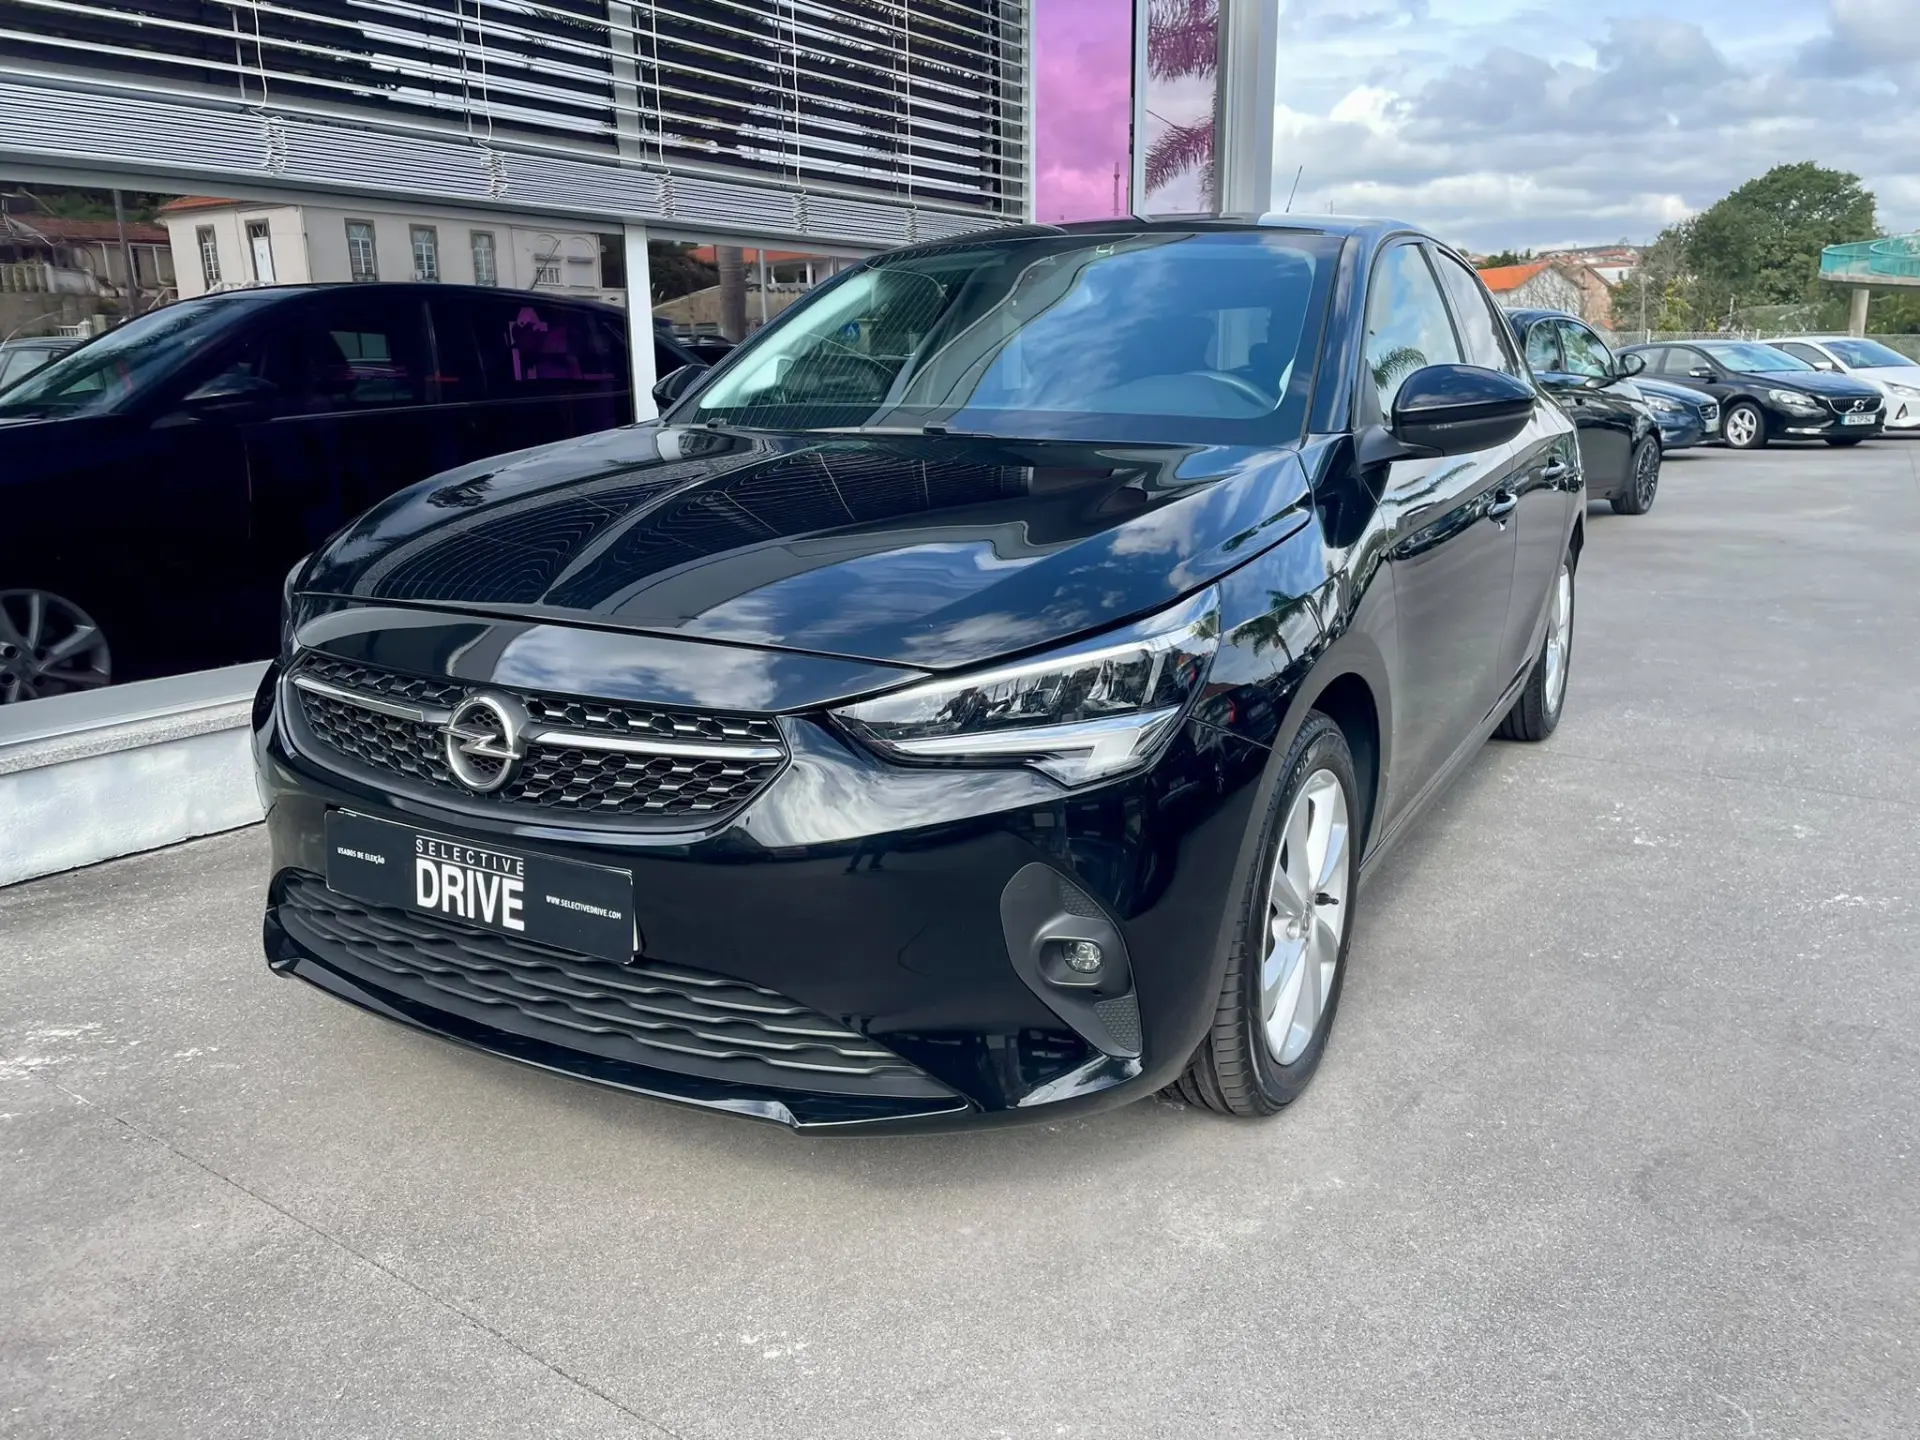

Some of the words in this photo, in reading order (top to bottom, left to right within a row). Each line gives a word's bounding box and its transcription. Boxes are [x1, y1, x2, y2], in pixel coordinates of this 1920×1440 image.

[337, 847, 357, 857] USADOS
[357, 851, 364, 859] DE
[416, 839, 524, 876] SELECTIVE
[416, 858, 525, 931] DRIVE
[546, 895, 622, 920] WWW.SELECTIVEDRIVE.COM
